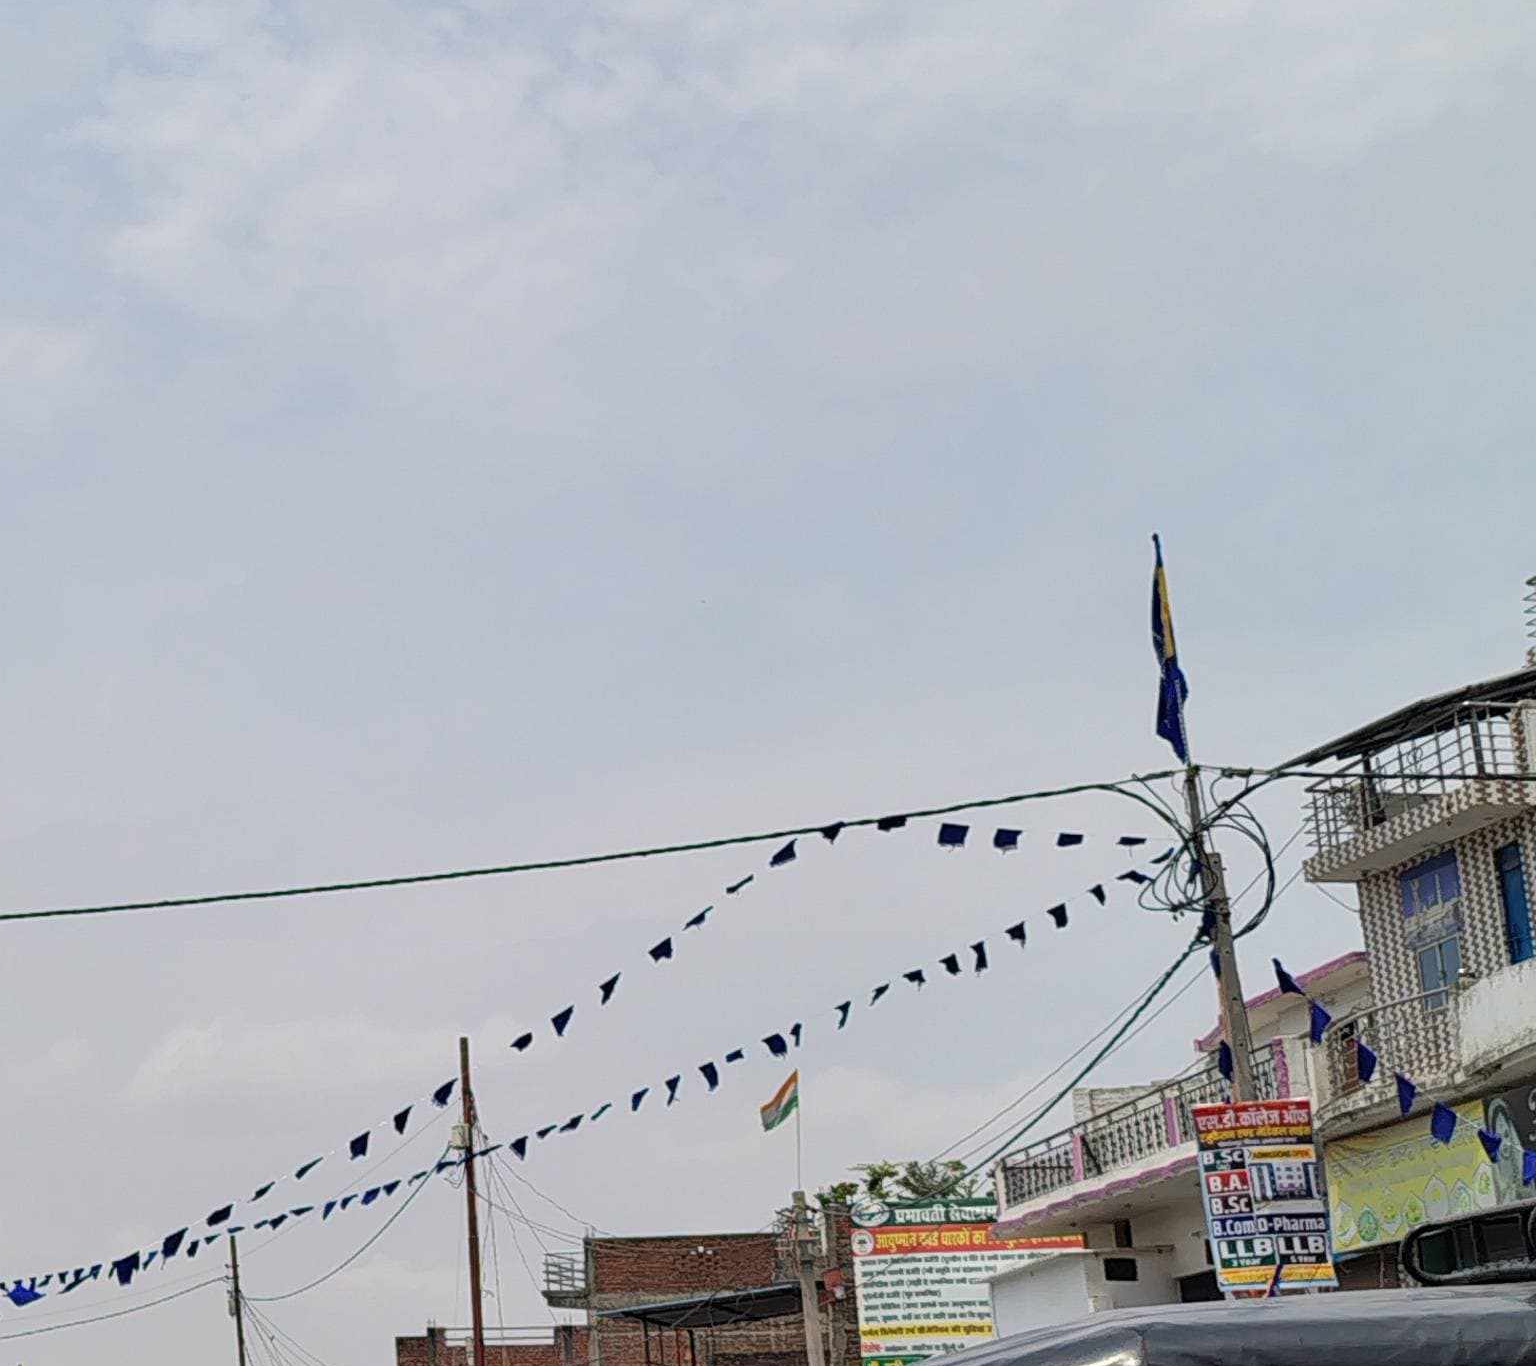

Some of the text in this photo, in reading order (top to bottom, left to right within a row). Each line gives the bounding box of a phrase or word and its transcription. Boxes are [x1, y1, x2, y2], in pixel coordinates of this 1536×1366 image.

[1208, 1174, 1248, 1193] B.A.
[1213, 1219, 1256, 1236] B.Com
[1257, 1217, 1326, 1235] D-Pharma
[1219, 1237, 1274, 1259] LLB
[1277, 1235, 1325, 1257] LLB
